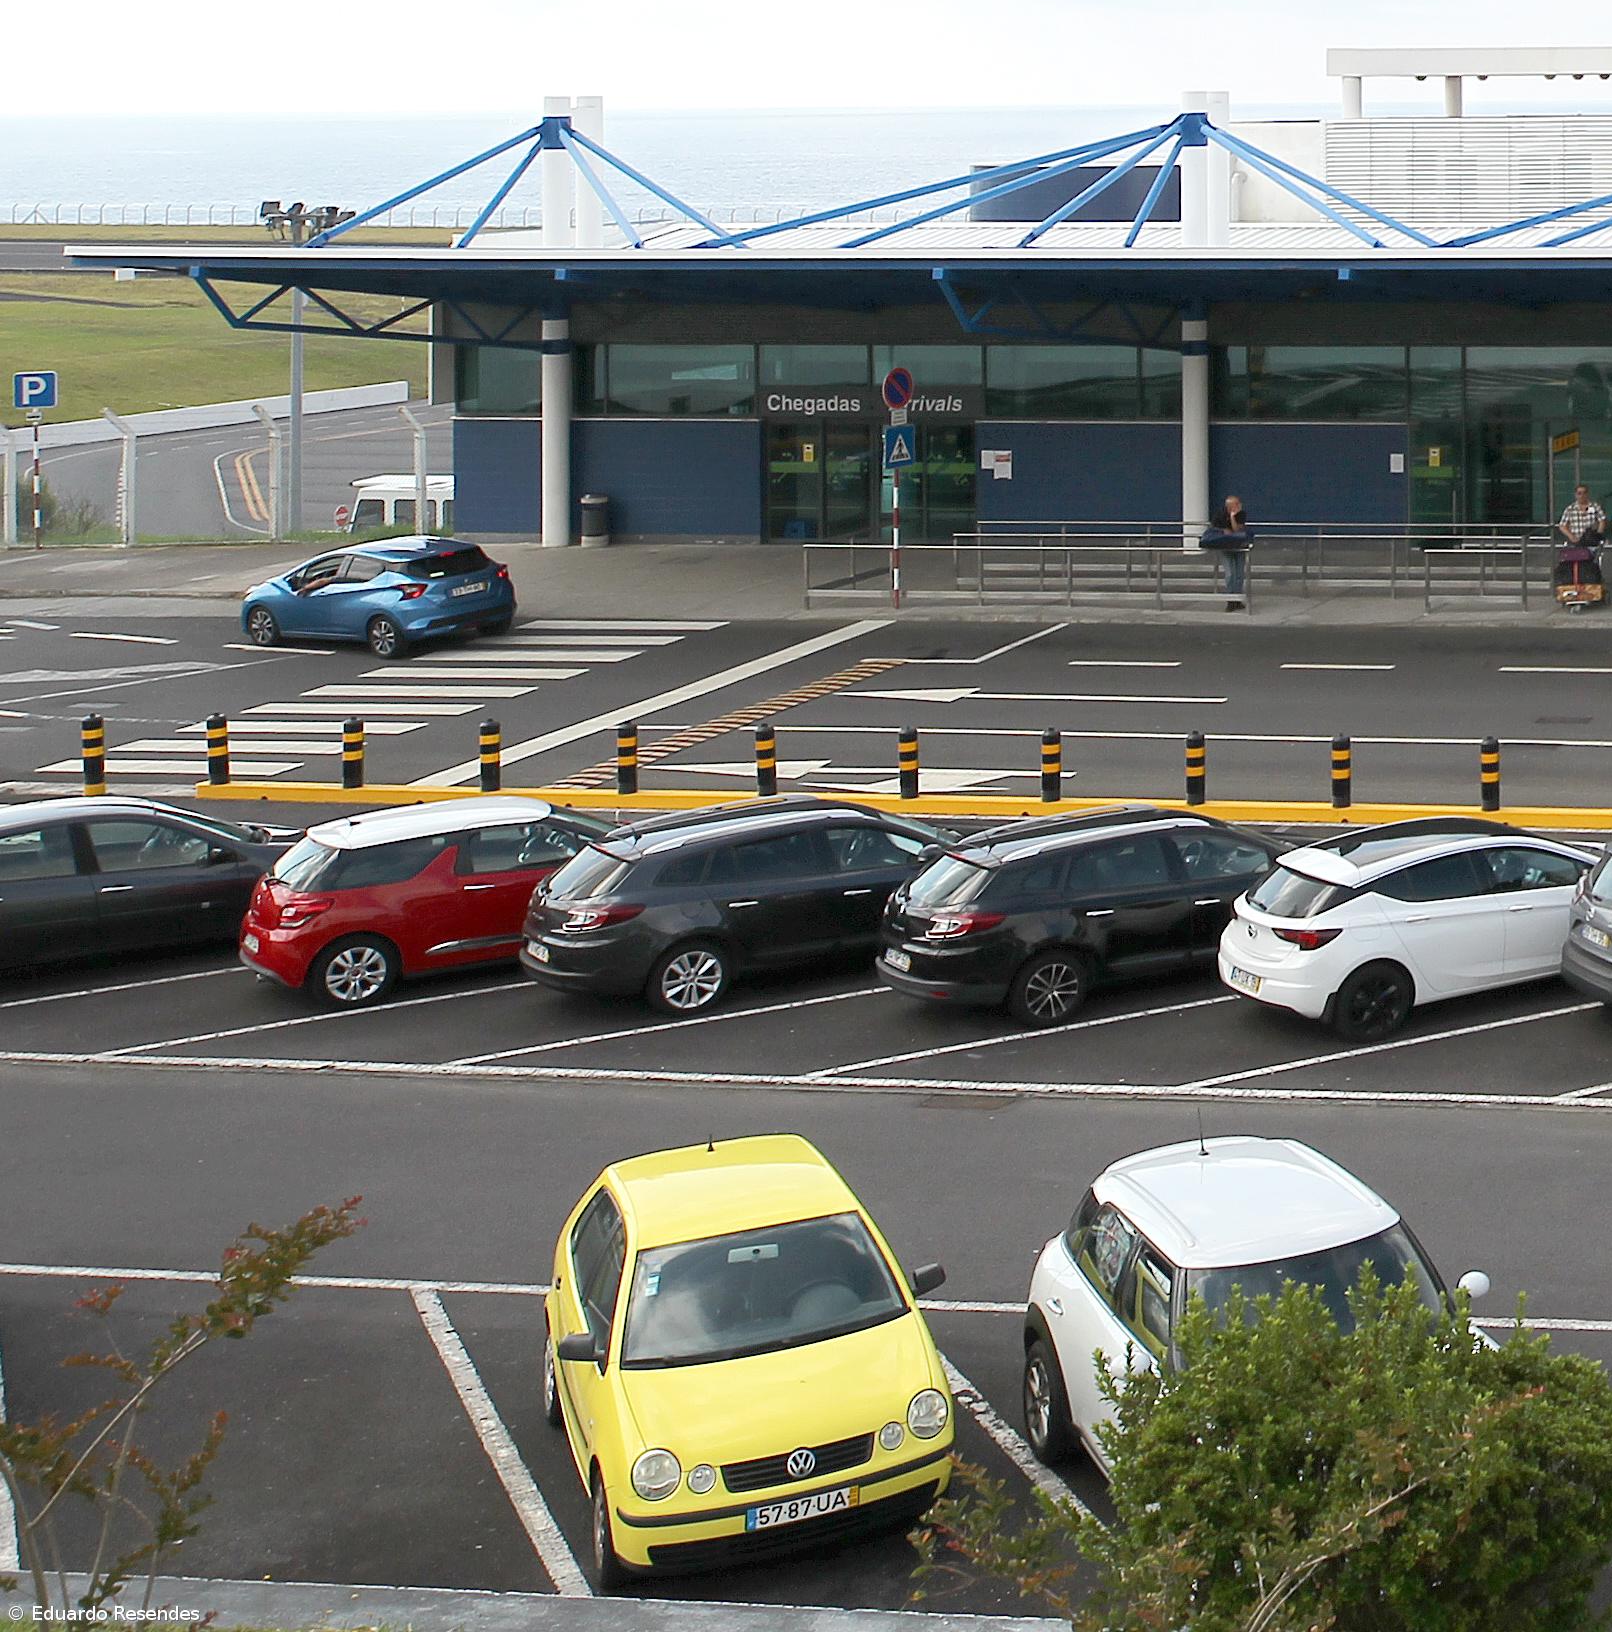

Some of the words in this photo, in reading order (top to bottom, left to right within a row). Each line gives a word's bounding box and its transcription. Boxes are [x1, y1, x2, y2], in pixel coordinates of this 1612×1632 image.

[22, 376, 46, 405] P
[767, 394, 861, 415] Chegadas
[888, 394, 963, 412] rrivals
